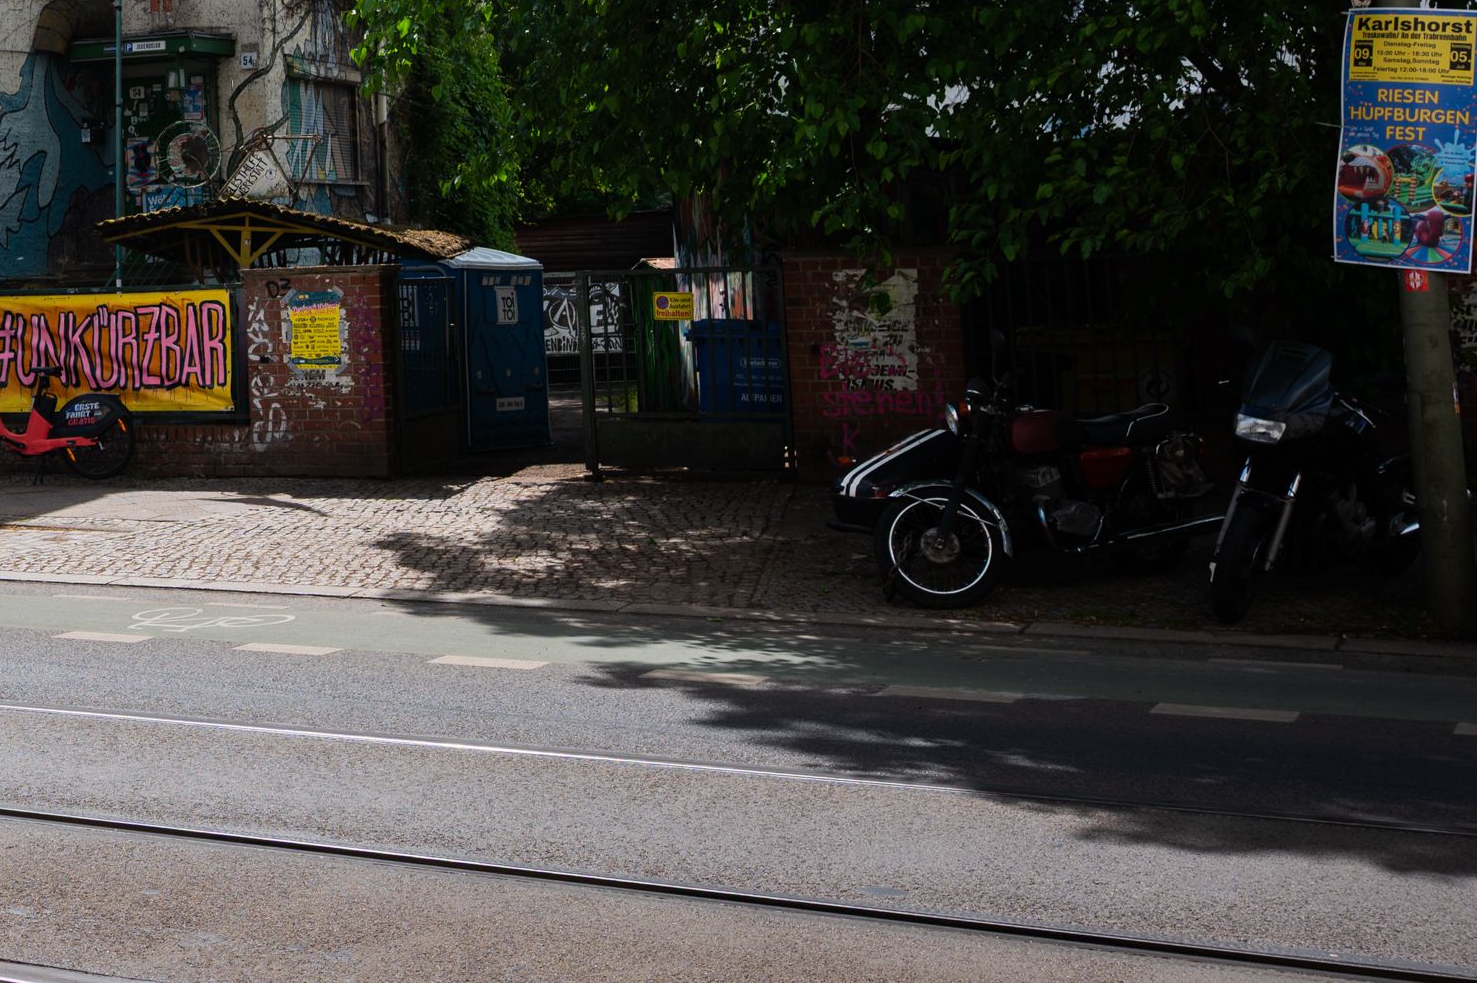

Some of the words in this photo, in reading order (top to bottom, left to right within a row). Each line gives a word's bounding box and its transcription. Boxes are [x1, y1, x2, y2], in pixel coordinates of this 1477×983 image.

[1358, 17, 1473, 34] Karlshorst
[1423, 32, 1467, 42] Trabrennbahn
[1354, 48, 1373, 60] 09.
[1377, 49, 1393, 57] 15:00
[1394, 49, 1406, 57] Uhr
[1450, 50, 1472, 63] 05.
[1378, 88, 1440, 105] RIESEN
[1350, 102, 1471, 126] HÜPFBURGEN
[1386, 126, 1427, 141] FEST
[74, 402, 100, 412] ERSTE
[66, 410, 91, 420] FAHRT
[68, 417, 96, 426] GRATIS
